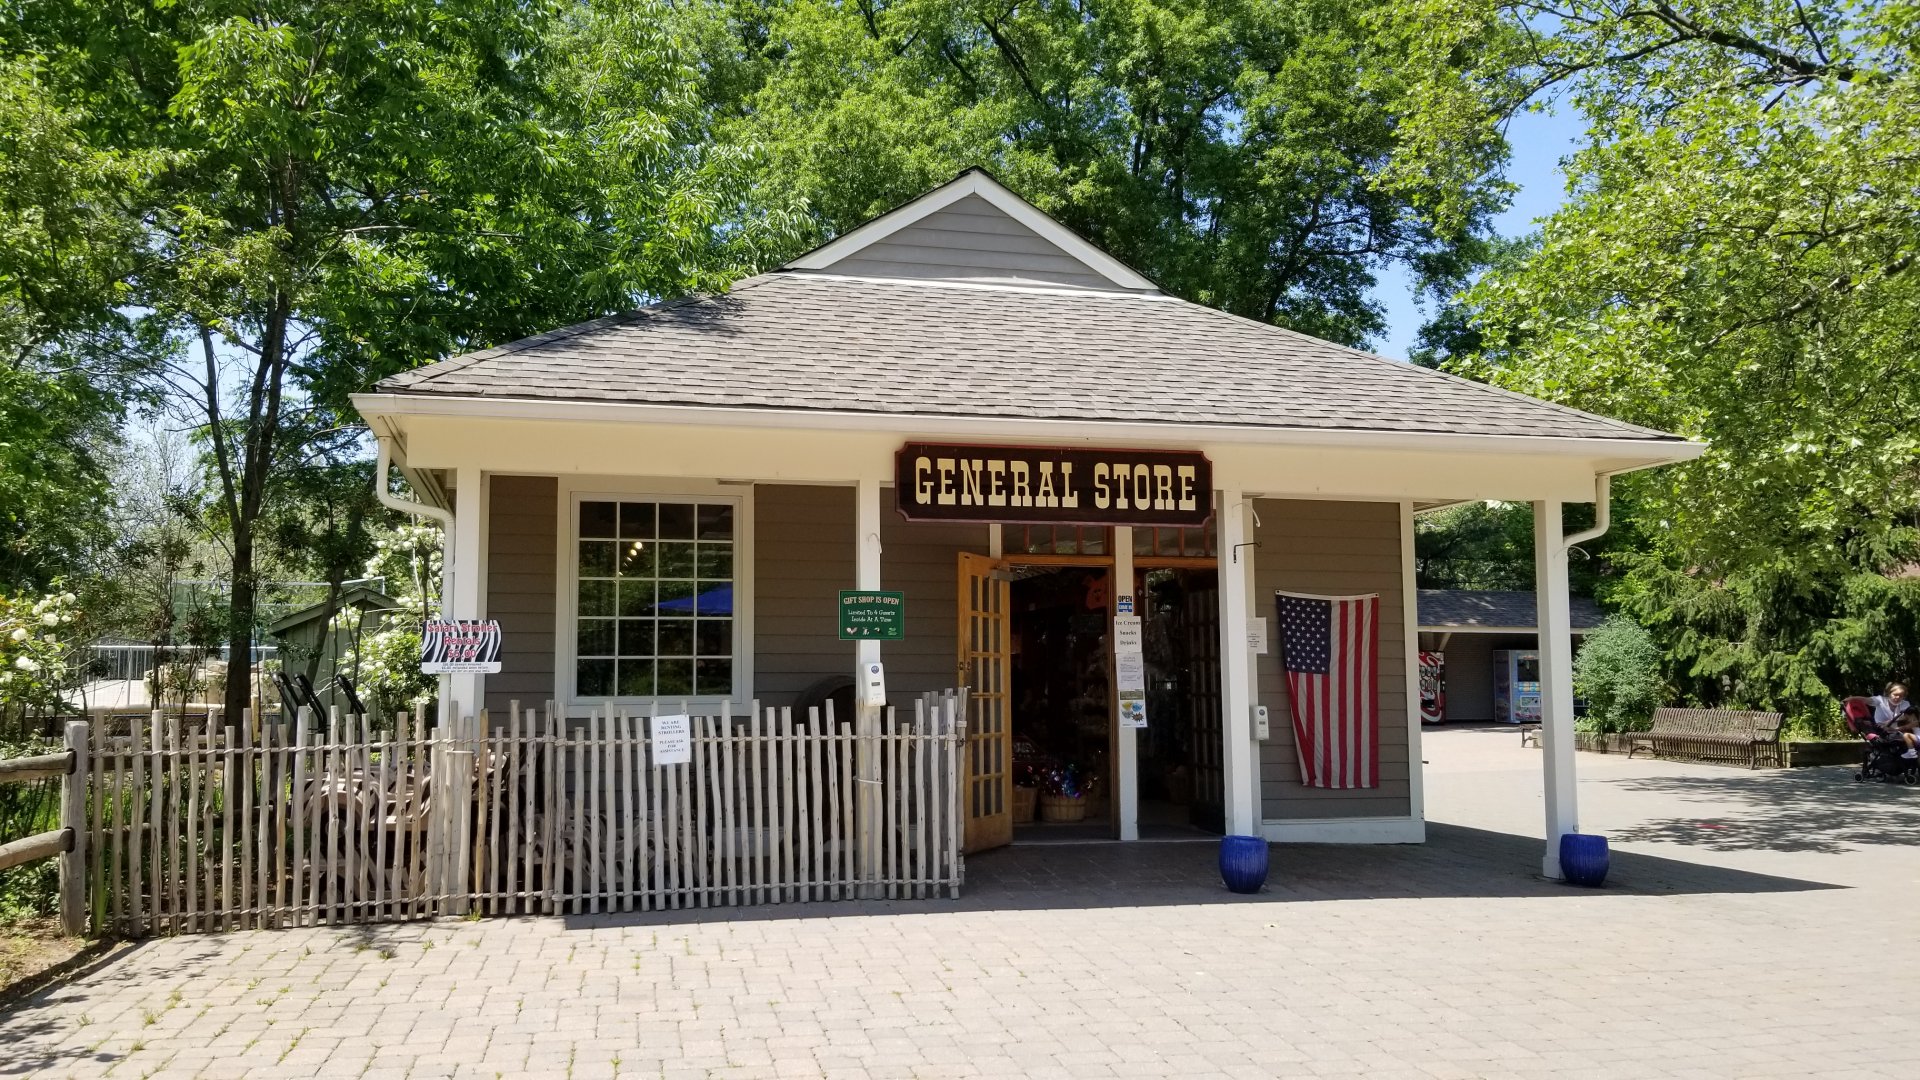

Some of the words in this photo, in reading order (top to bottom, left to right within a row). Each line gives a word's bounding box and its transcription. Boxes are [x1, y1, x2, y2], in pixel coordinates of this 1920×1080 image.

[915, 456, 1078, 508] GENERAL
[1094, 462, 1196, 511] STORE
[843, 596, 857, 605] GIFT
[858, 596, 875, 604] SHOP
[875, 596, 882, 604] IS
[882, 597, 900, 606] OPEN
[1117, 595, 1133, 603] OPEN
[427, 623, 458, 633] Safari
[460, 623, 498, 633] Stroller
[444, 636, 481, 645] Rentals
[448, 649, 476, 658] $5.00
